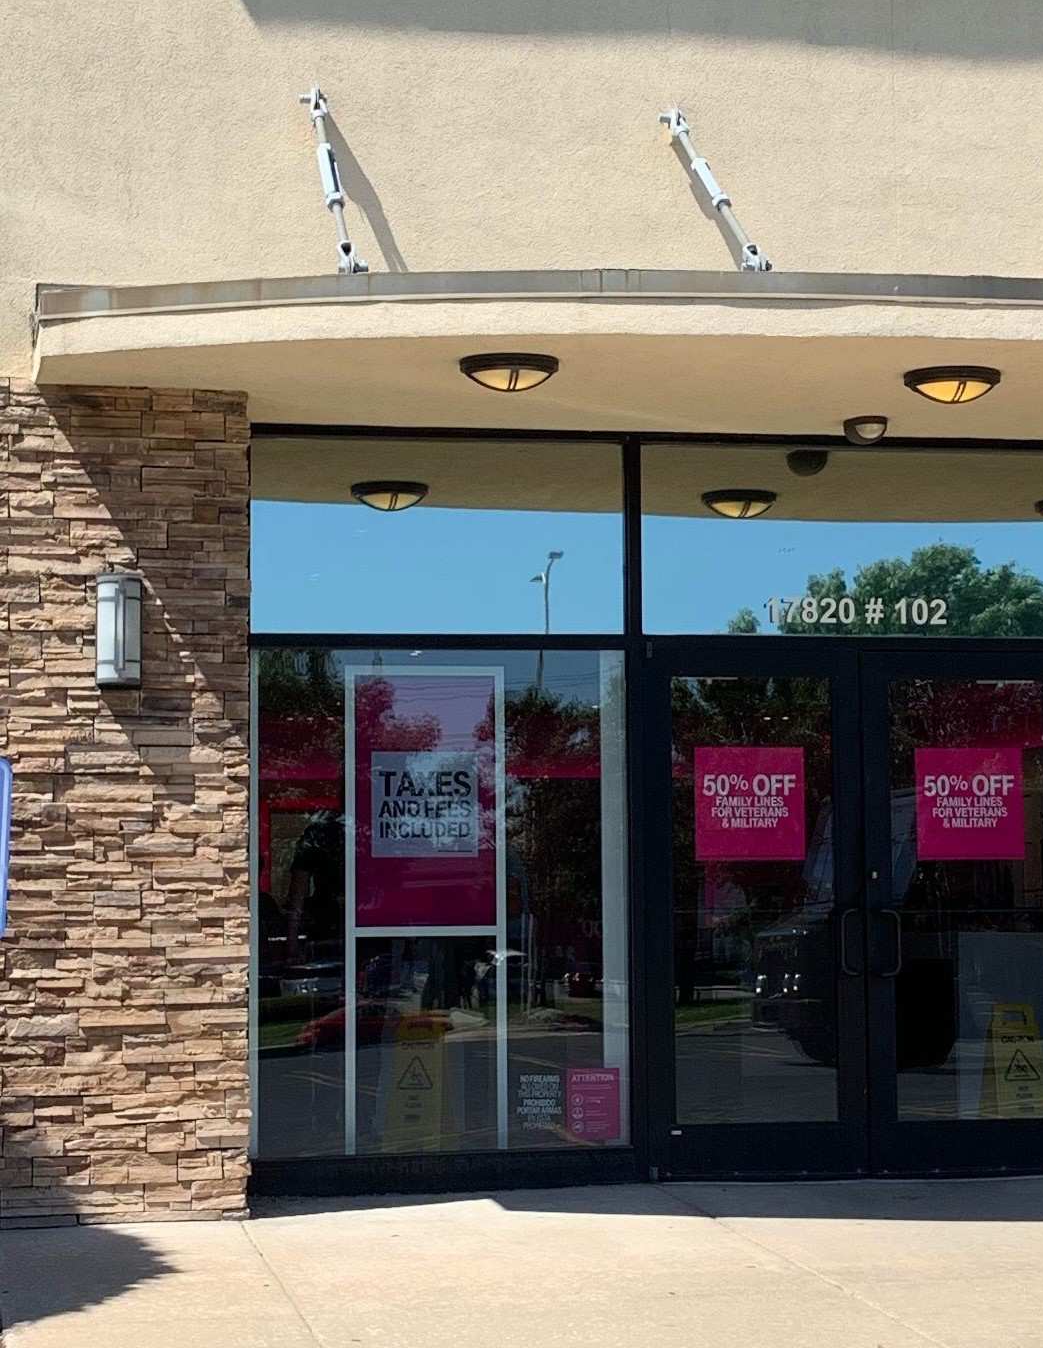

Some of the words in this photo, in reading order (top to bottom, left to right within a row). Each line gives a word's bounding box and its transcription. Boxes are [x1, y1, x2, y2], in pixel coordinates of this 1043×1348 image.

[765, 597, 856, 625] 17820
[894, 598, 947, 625] 102
[703, 774, 749, 797] 50%
[752, 774, 797, 797] OFF
[924, 774, 969, 797] 50%
[972, 774, 1015, 797] OFF
[716, 796, 753, 807] FAMILY
[754, 796, 784, 807] LINES
[936, 796, 973, 808] FAMILY
[974, 796, 1004, 807] LINES
[378, 800, 420, 819] AND
[424, 800, 473, 819] FEES
[711, 807, 733, 818] FOR
[734, 807, 789, 818] VETERANS
[932, 807, 953, 819] FOR
[954, 807, 1008, 818] VETERANS
[721, 818, 729, 829] &
[731, 818, 779, 829] MILITARY
[943, 818, 950, 829] &
[951, 818, 999, 829] MILITARY
[379, 821, 471, 839] INCLUDED
